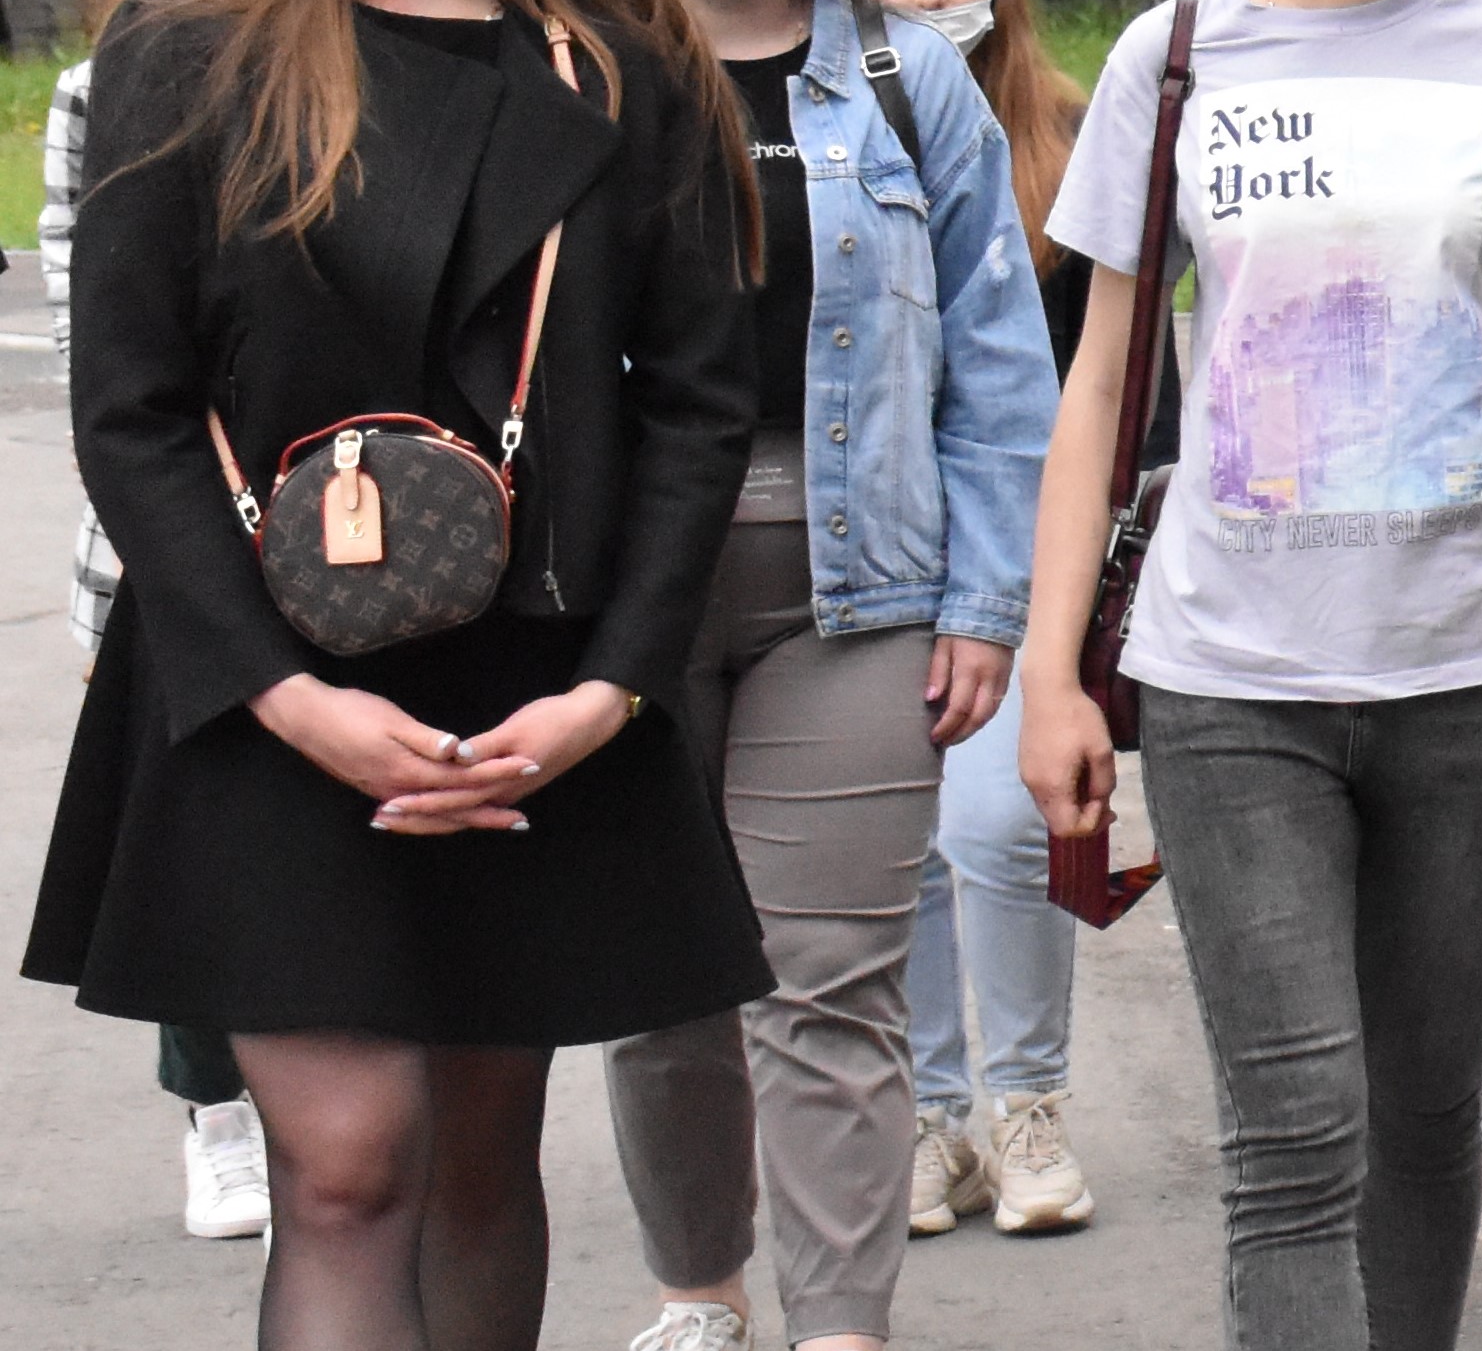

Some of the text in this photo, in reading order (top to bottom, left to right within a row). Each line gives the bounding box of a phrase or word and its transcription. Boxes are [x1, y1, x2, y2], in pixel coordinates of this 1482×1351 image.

[1208, 104, 1315, 155] New
[1209, 155, 1336, 221] York
[1217, 516, 1277, 553] CITY
[1287, 511, 1378, 551] NEVER
